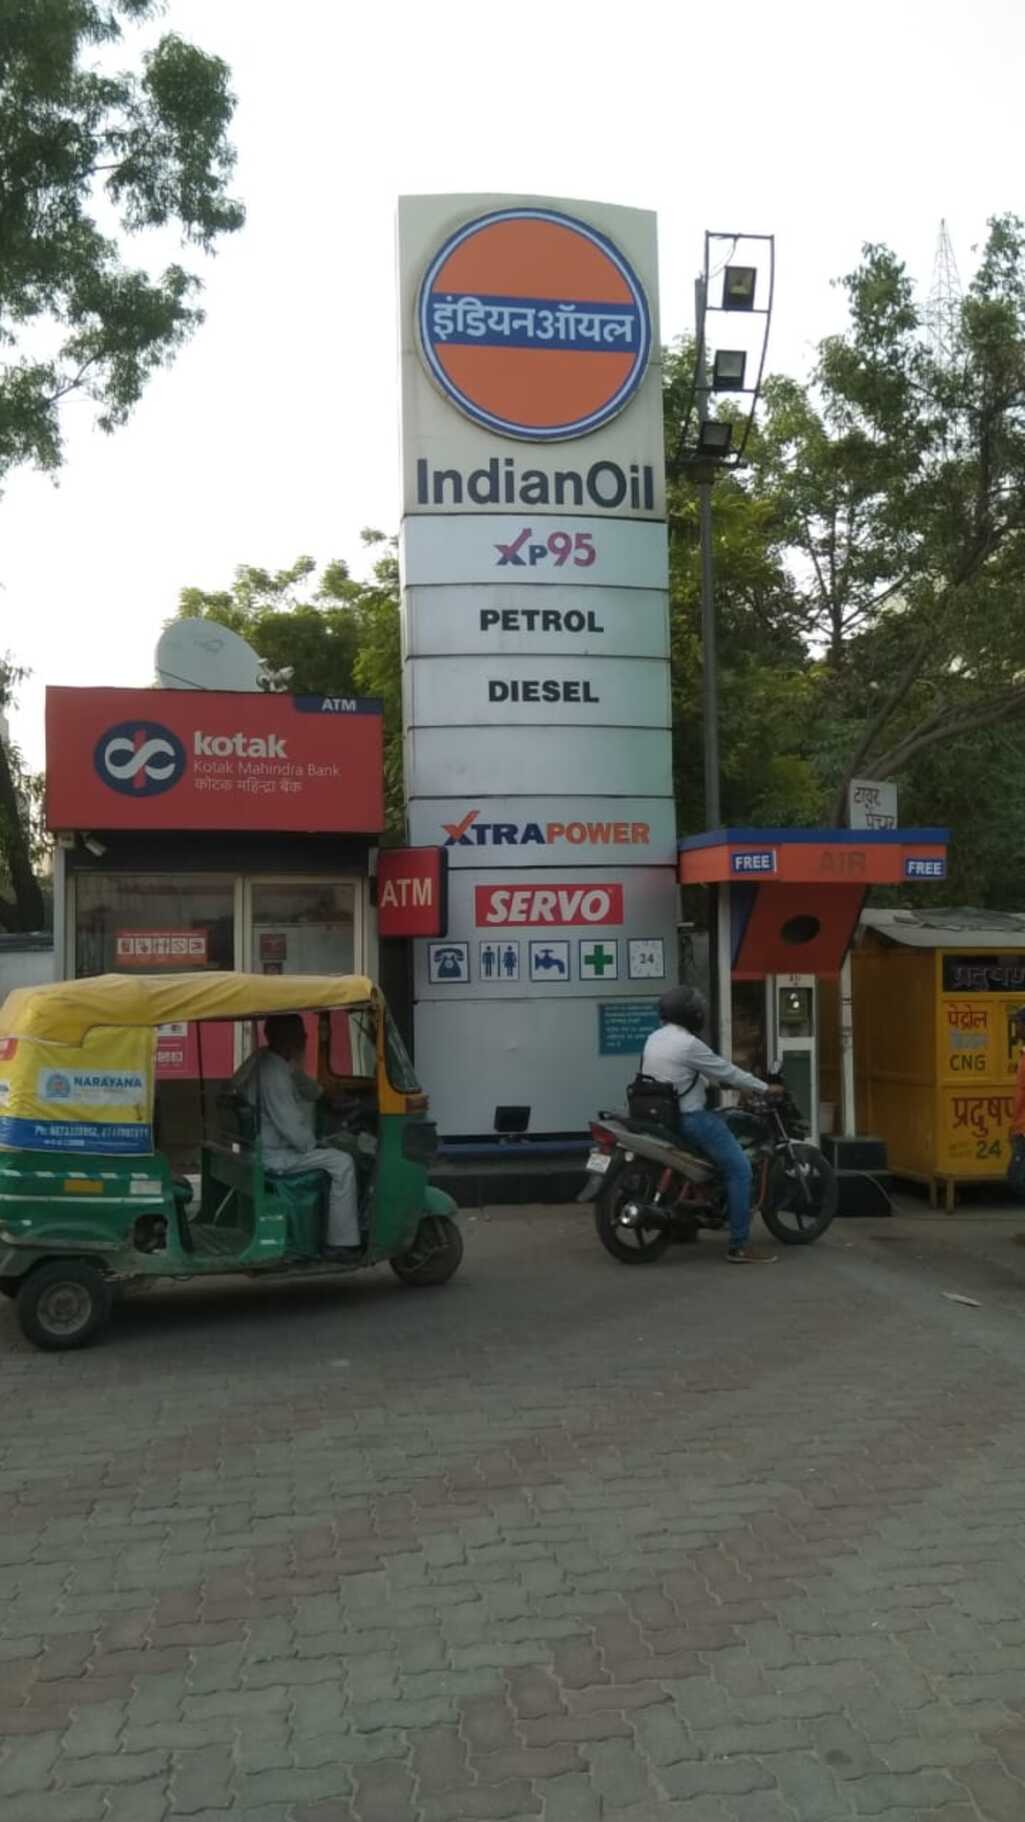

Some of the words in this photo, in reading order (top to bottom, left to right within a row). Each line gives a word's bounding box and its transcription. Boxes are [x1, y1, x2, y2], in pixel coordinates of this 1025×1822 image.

[433, 297, 635, 343] इंडियनऑयल
[417, 458, 655, 511] IndianOil
[493, 527, 597, 568] XP95
[480, 609, 604, 634] PETROL
[488, 680, 599, 704] DIESEL
[321, 698, 357, 712] ATM
[193, 730, 288, 760] kotak
[193, 760, 234, 775] Kotak
[237, 762, 304, 777] Mahindra
[307, 763, 340, 778] Bank
[440, 810, 650, 847] XTRAPOWER
[734, 854, 770, 870] FREE
[908, 861, 943, 876] FREE
[380, 877, 432, 908] ATM
[486, 889, 611, 924] SERVO
[950, 1054, 986, 1072] CNG
[73, 1076, 143, 1090] NARAYANA
[976, 1139, 1002, 1159] 24
